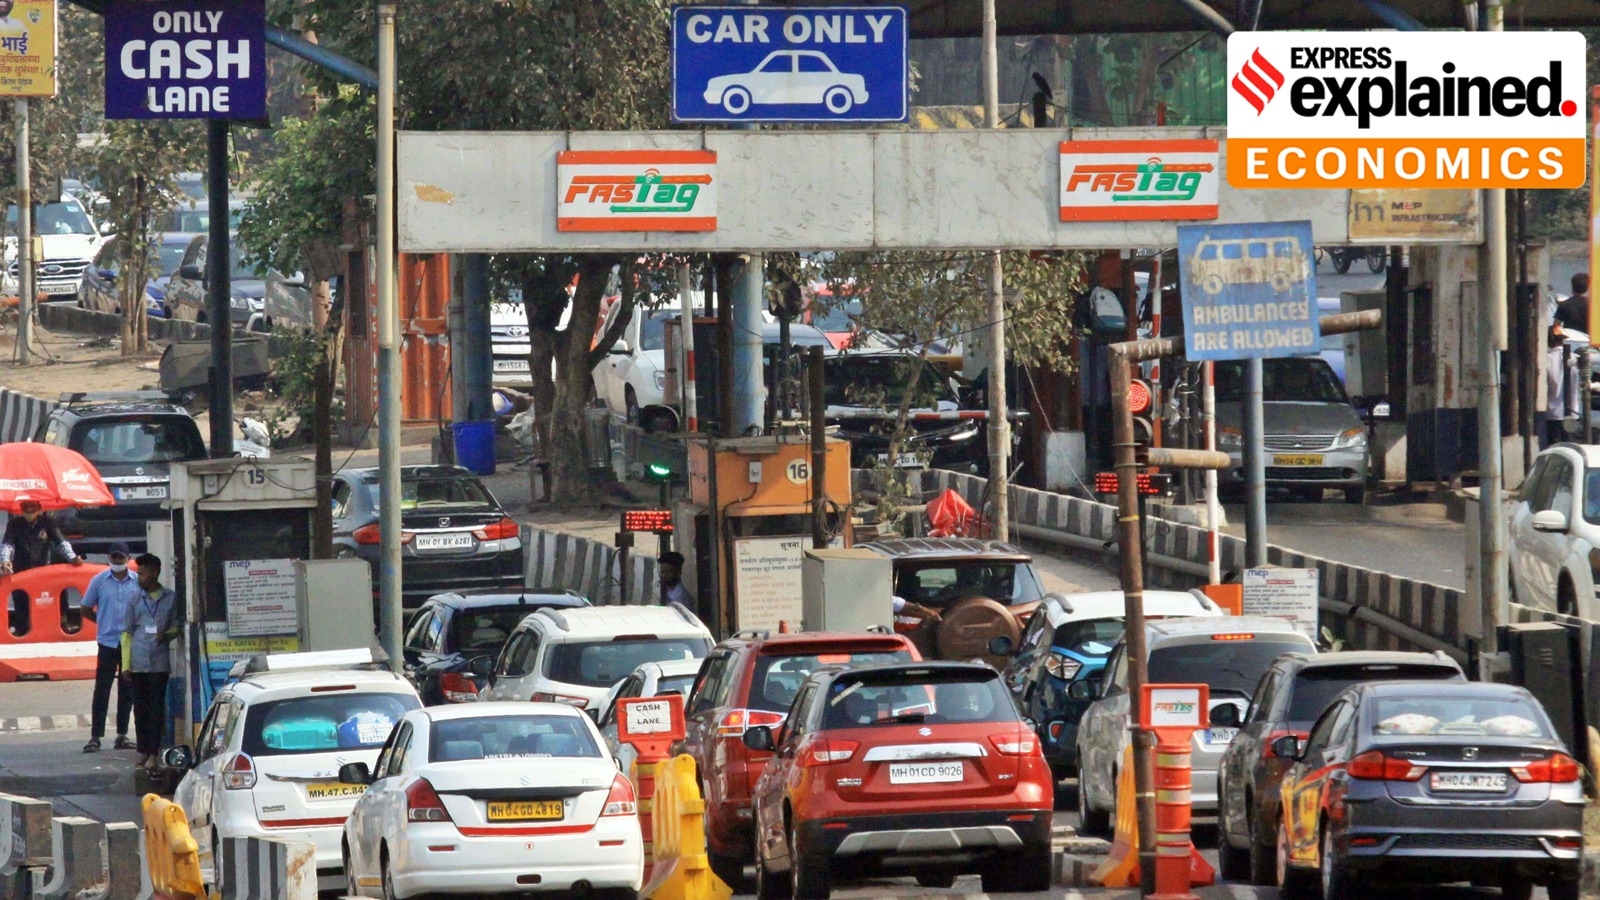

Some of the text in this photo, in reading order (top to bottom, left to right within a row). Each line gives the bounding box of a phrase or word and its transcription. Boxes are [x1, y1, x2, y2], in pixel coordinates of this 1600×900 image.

[153, 11, 223, 33] ONLY
[686, 15, 892, 43] CAR ONLY
[120, 39, 250, 79] CASH
[147, 86, 229, 112] LANE
[1391, 202, 1422, 210] MEP
[1193, 301, 1309, 325] AMBULANCES
[1194, 327, 1314, 351] ARE ALLOWED
[248, 469, 265, 485] 15
[790, 464, 808, 480] 16
[433, 538, 441, 546] 01
[781, 542, 800, 550] सूचना
[229, 561, 250, 569] mep
[1248, 570, 1268, 578] mep
[636, 704, 660, 712] CASH
[637, 717, 661, 725] LANE
[891, 768, 907, 778] MH
[939, 766, 962, 776] 9026
